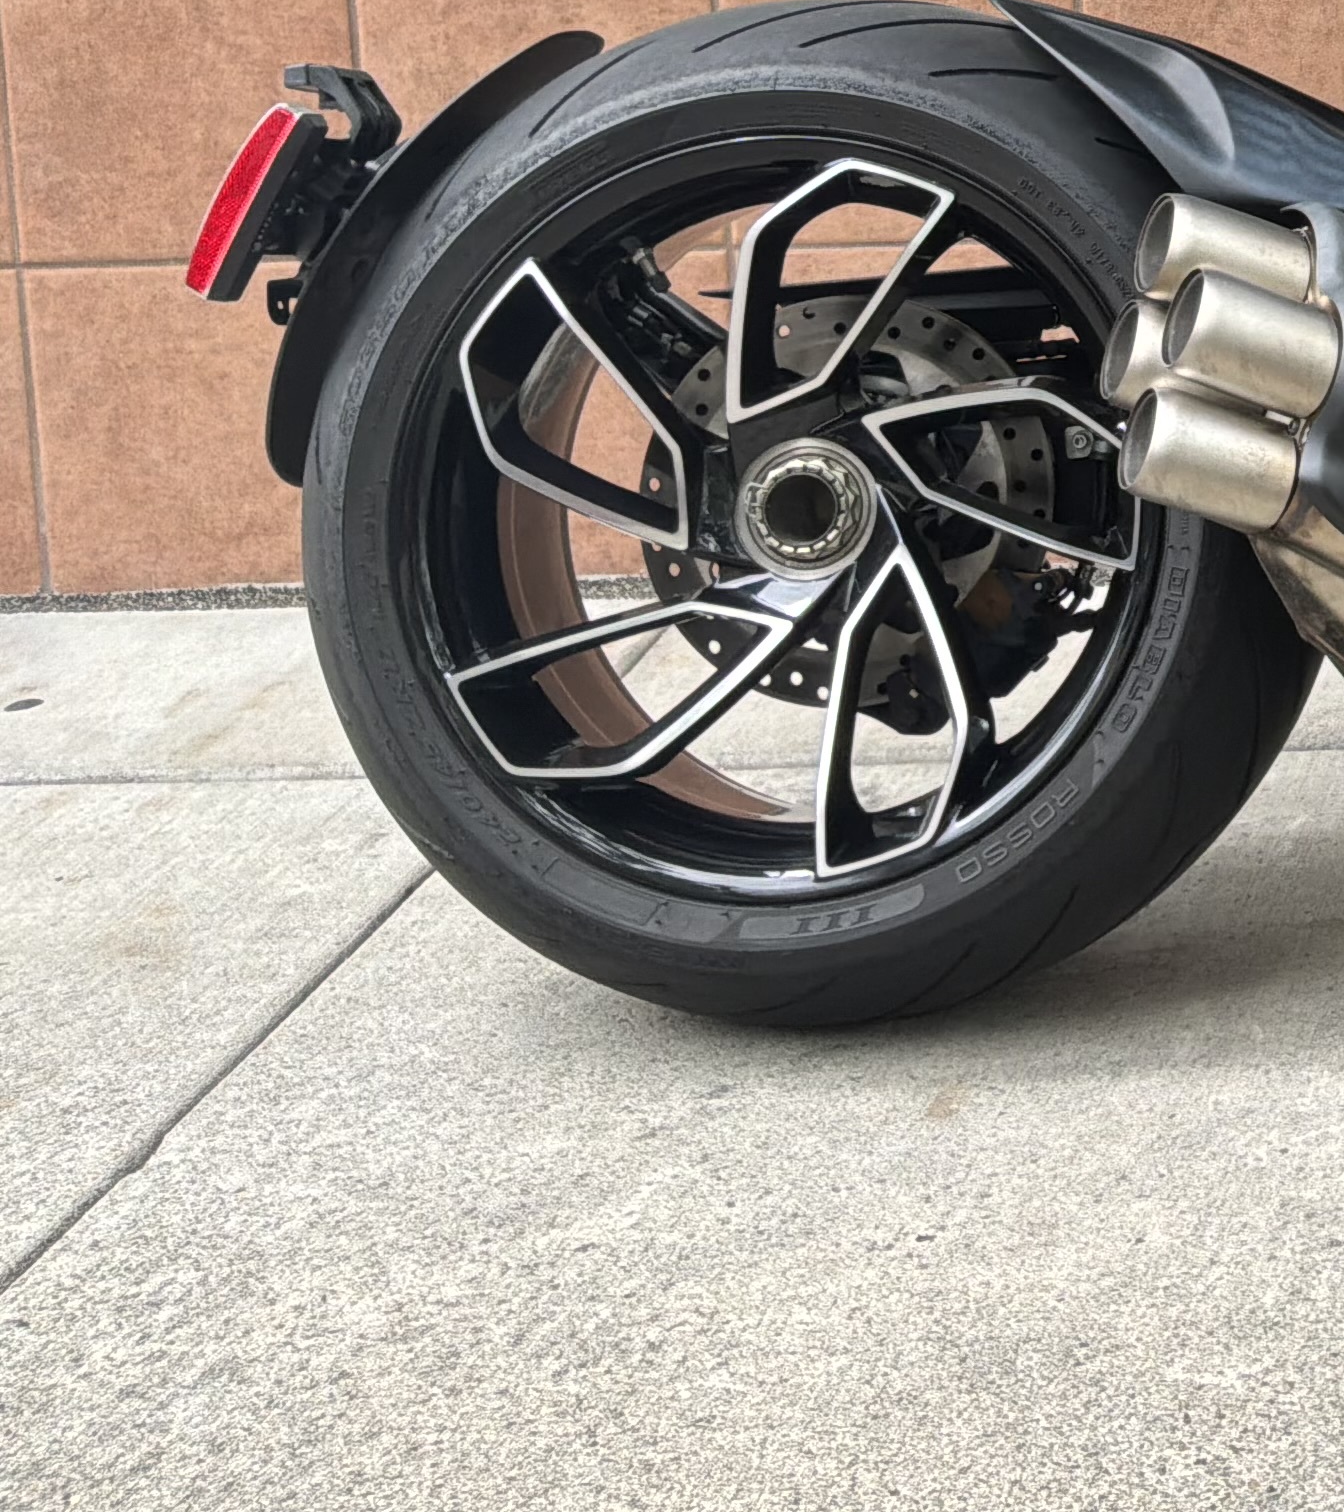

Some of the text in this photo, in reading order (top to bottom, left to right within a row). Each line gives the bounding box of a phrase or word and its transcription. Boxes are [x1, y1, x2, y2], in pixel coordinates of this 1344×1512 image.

[796, 566, 1189, 936] DIABLO ROSSO III
